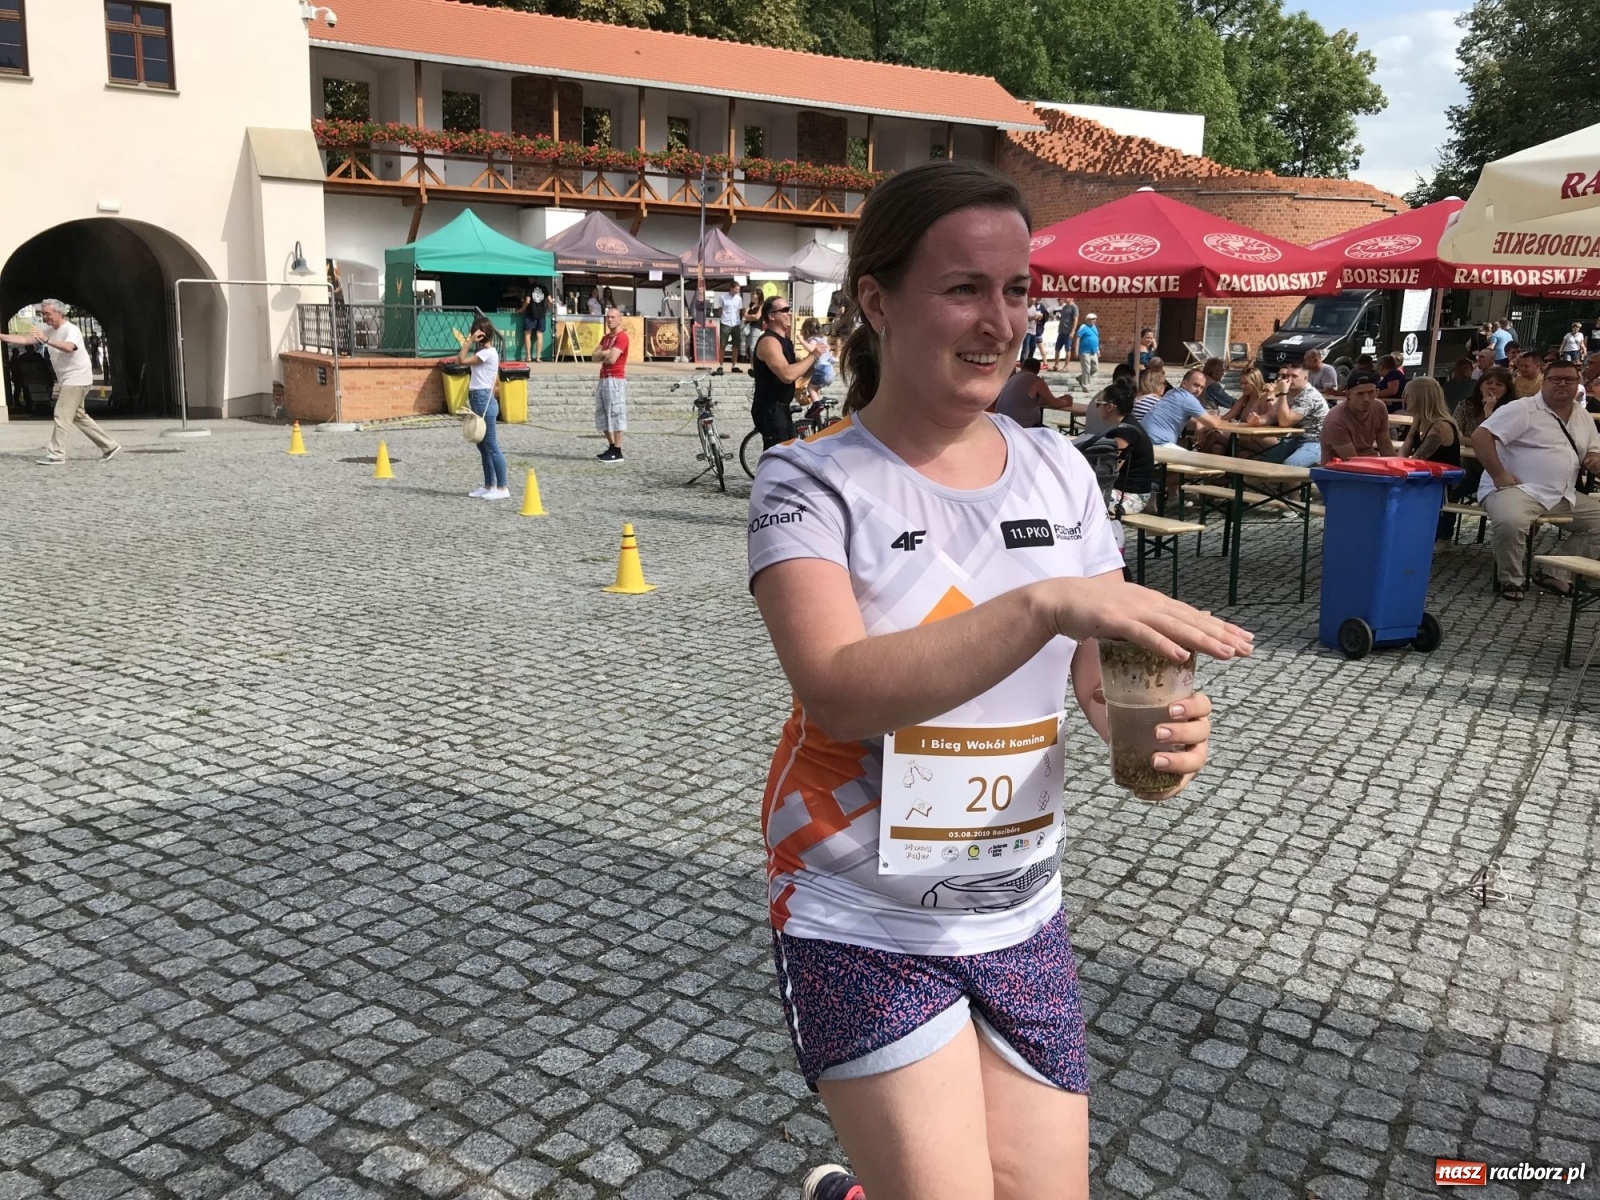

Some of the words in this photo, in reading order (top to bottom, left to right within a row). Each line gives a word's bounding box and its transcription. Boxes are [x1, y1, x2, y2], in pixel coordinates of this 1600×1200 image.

[1041, 274, 1180, 294] RACIBORSKIE
[1216, 271, 1328, 292] RACIBORSKIE
[1343, 268, 1420, 284] BORSKIE
[1453, 268, 1587, 285] RACIBORSKIE
[891, 530, 927, 551] 4F
[931, 739, 961, 752] Bieg
[966, 738, 1006, 750] Wokół
[1009, 735, 1045, 749] Komina
[965, 775, 1013, 813] 20
[948, 830, 990, 839] 03.08.2019
